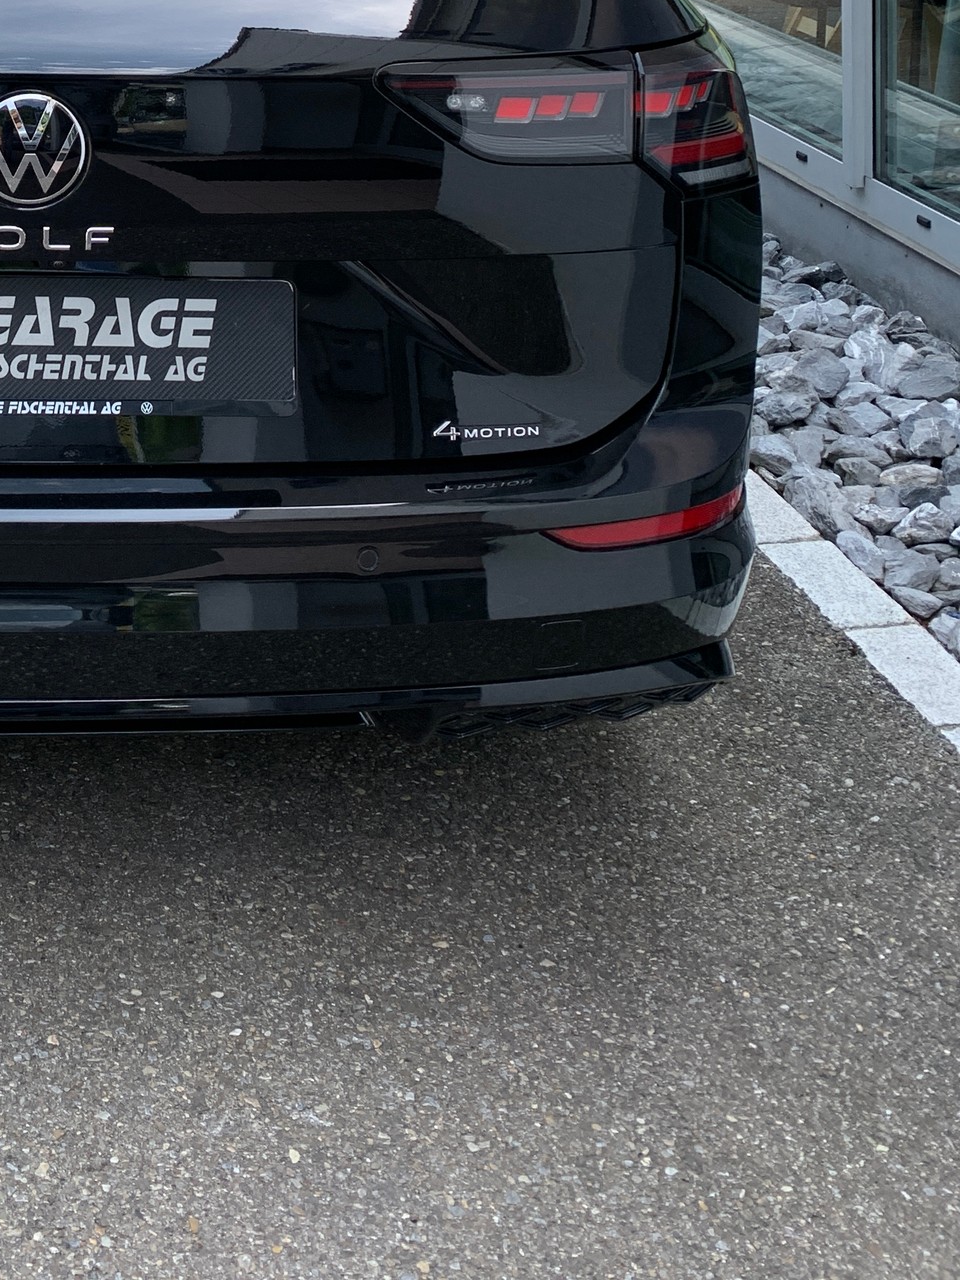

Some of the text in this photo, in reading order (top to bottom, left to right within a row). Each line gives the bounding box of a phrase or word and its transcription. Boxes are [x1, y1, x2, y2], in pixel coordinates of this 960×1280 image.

[164, 356, 208, 381] AG
[8, 401, 97, 415] FISCHENTHAL
[100, 402, 122, 415] AG
